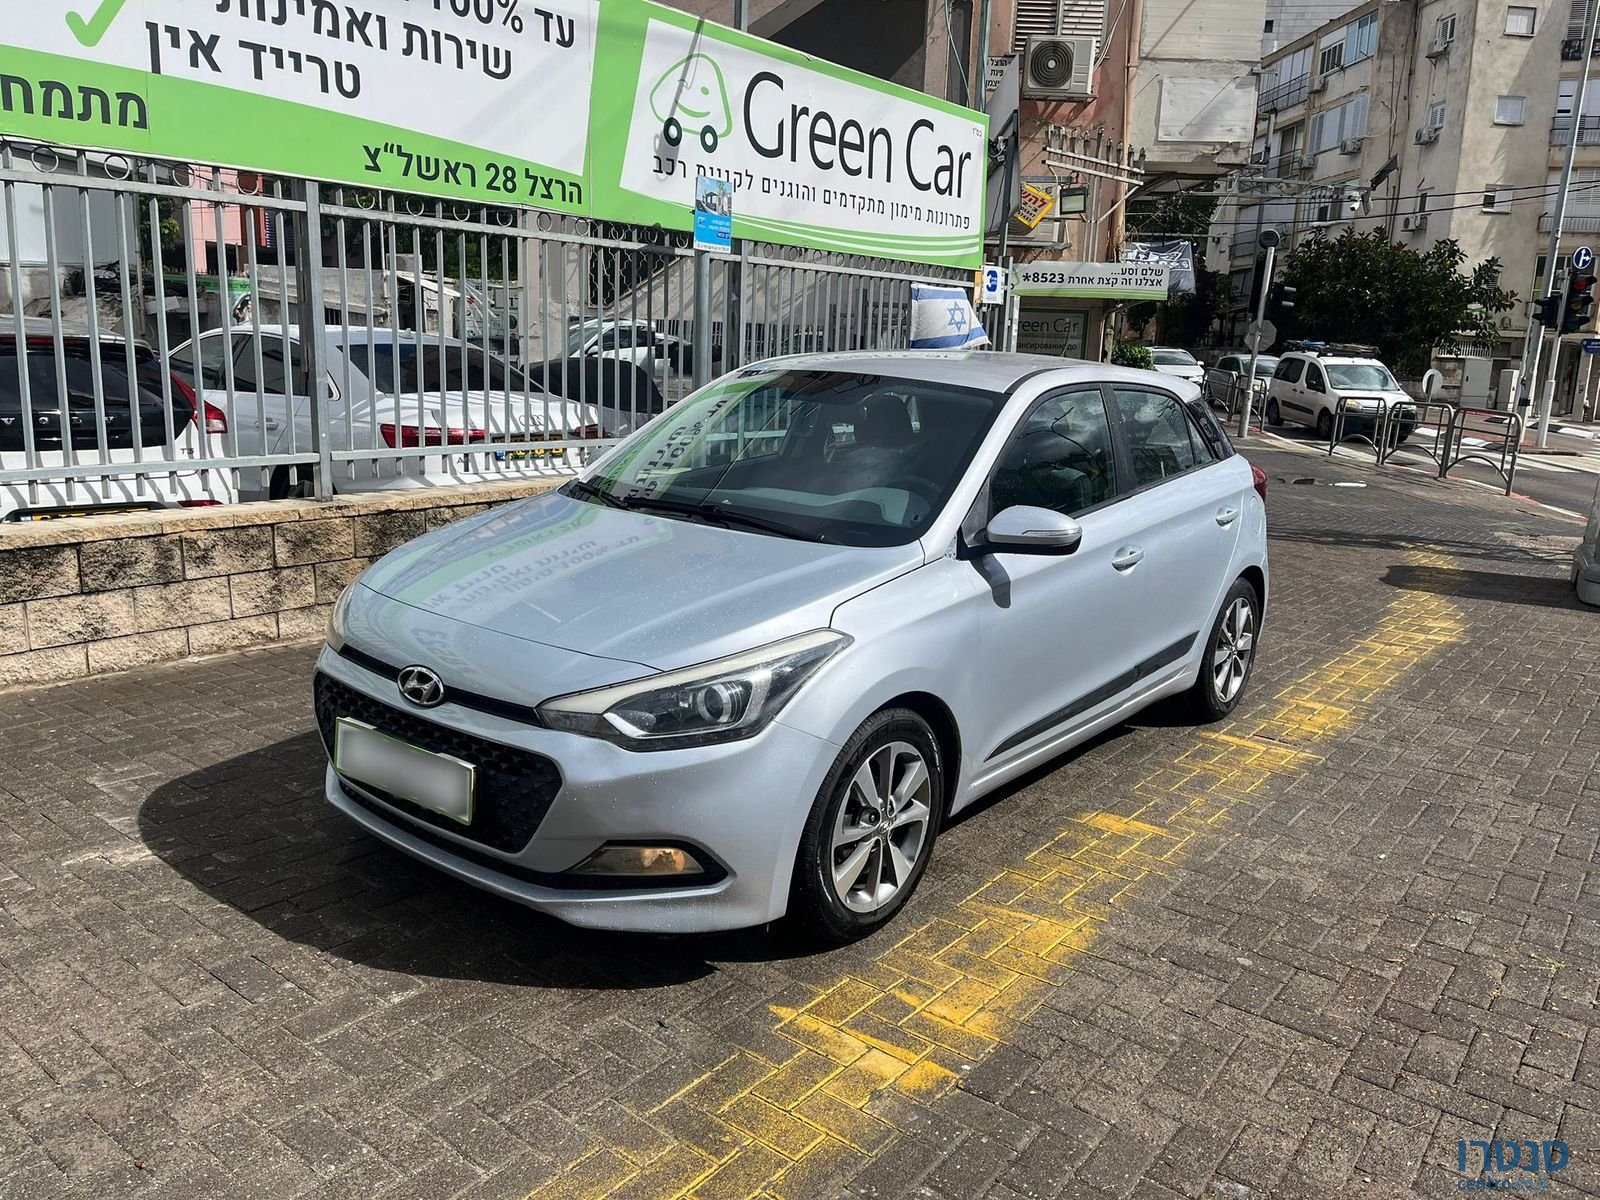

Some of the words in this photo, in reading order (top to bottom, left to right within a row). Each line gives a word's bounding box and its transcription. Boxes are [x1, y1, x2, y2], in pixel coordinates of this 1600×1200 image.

[433, 0, 523, 34] 00%
[535, 8, 574, 48] עד
[145, 21, 222, 74] אין
[402, 22, 512, 79] שירות
[238, 39, 361, 99] טרייד
[743, 71, 893, 184] Green
[906, 118, 972, 198] Car
[485, 163, 517, 194] 28
[653, 155, 687, 178] רכב
[524, 167, 582, 205] הרצל
[761, 177, 816, 202] והוגנים
[823, 189, 885, 215] מתקדמים
[891, 201, 922, 221] מימון
[926, 207, 970, 229] פתרונות
[1067, 275, 1095, 286] אחרת
[1097, 276, 1118, 288] קצת
[1121, 277, 1132, 287] זה
[1135, 276, 1163, 287] אצלנו
[1141, 267, 1164, 277] שלם
[1012, 319, 1049, 332] reen
[1053, 317, 1079, 333] Car
